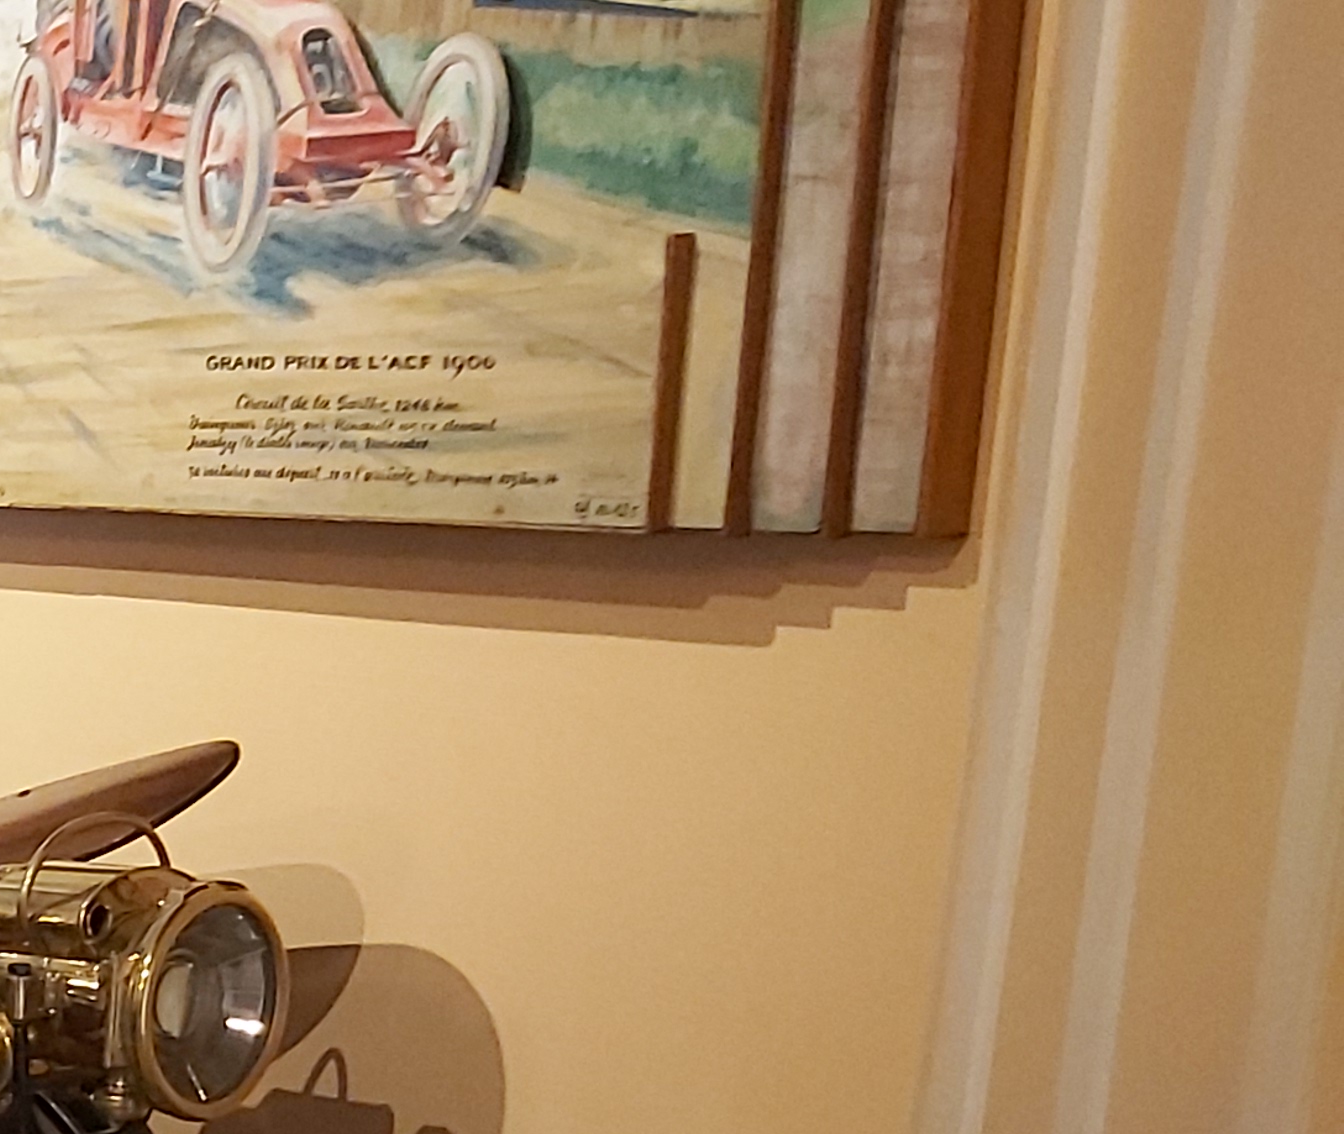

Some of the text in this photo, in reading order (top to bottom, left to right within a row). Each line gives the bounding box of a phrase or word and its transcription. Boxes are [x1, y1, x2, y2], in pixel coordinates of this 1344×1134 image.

[205, 355, 276, 371] GRAND
[283, 355, 329, 371] PRIX
[334, 355, 362, 371] DE
[367, 354, 432, 371] L'ACF
